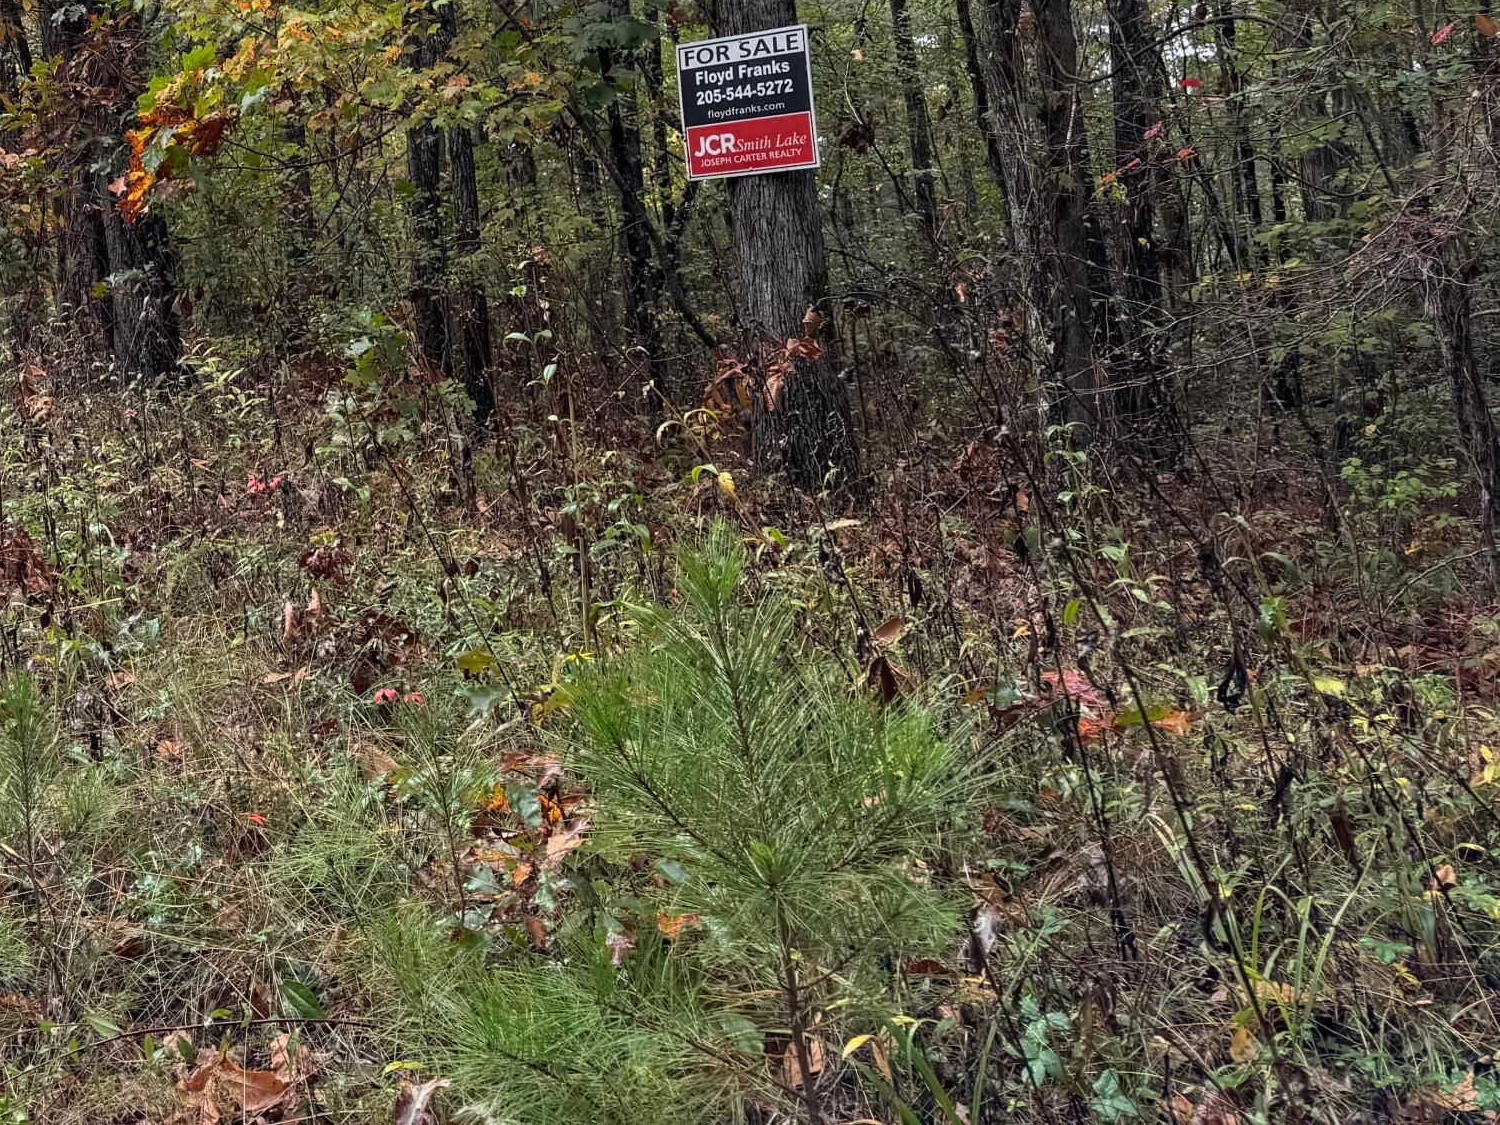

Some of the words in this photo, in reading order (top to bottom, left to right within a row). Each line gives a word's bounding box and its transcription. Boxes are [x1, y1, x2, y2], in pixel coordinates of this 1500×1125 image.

[684, 45, 730, 67] FOR
[739, 33, 799, 58] SALE
[695, 67, 733, 85] Floyd
[738, 60, 790, 79] Franks
[696, 78, 793, 105] 205-544-5272
[707, 101, 785, 119] floydfranks.com
[694, 133, 737, 158] JCR
[736, 136, 771, 152] Smith
[775, 131, 807, 147] Lake
[700, 156, 732, 167] JOSEPH
[733, 151, 767, 163] CARTER
[769, 148, 802, 159] REALTY
